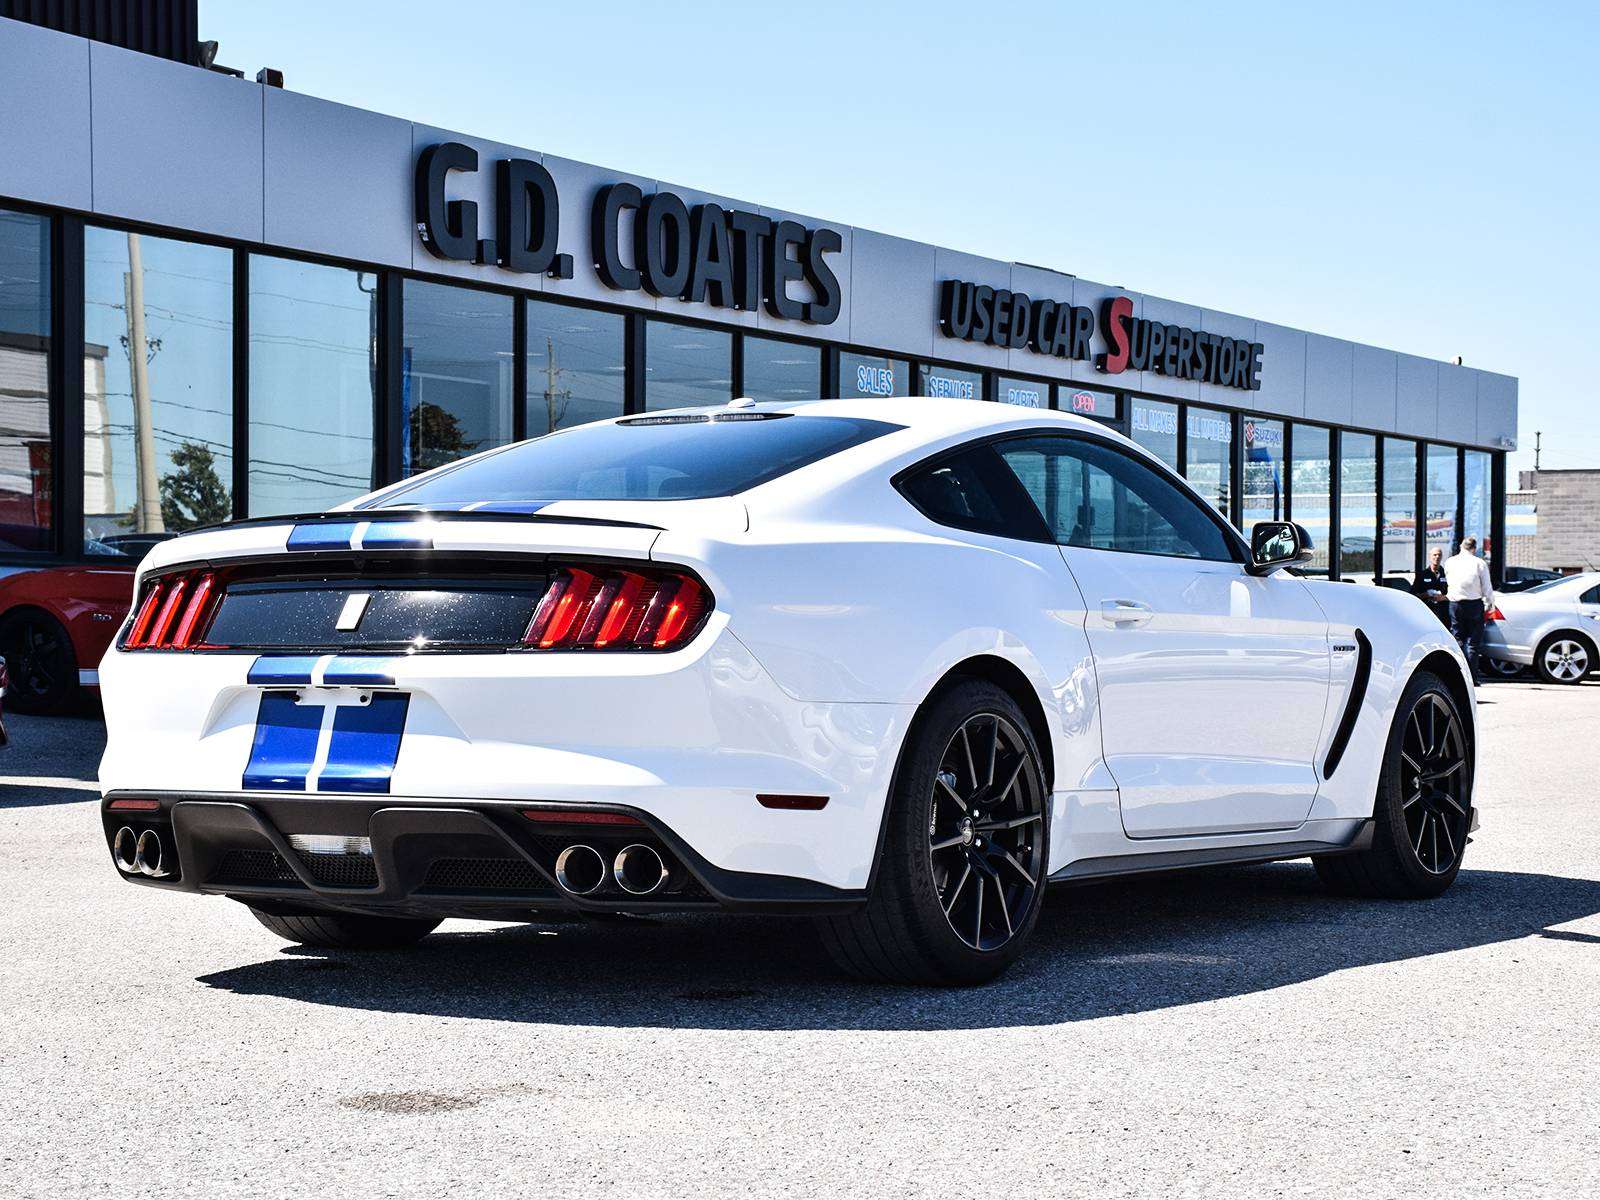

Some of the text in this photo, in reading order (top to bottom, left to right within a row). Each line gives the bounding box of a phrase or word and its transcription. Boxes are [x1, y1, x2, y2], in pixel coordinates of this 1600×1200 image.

[414, 142, 842, 325] G.D. COATES
[938, 279, 1264, 391] USED CAR SUPERSTORE
[857, 365, 893, 396] SALES
[930, 376, 973, 399] SERVICE
[1073, 393, 1096, 411] OPEN
